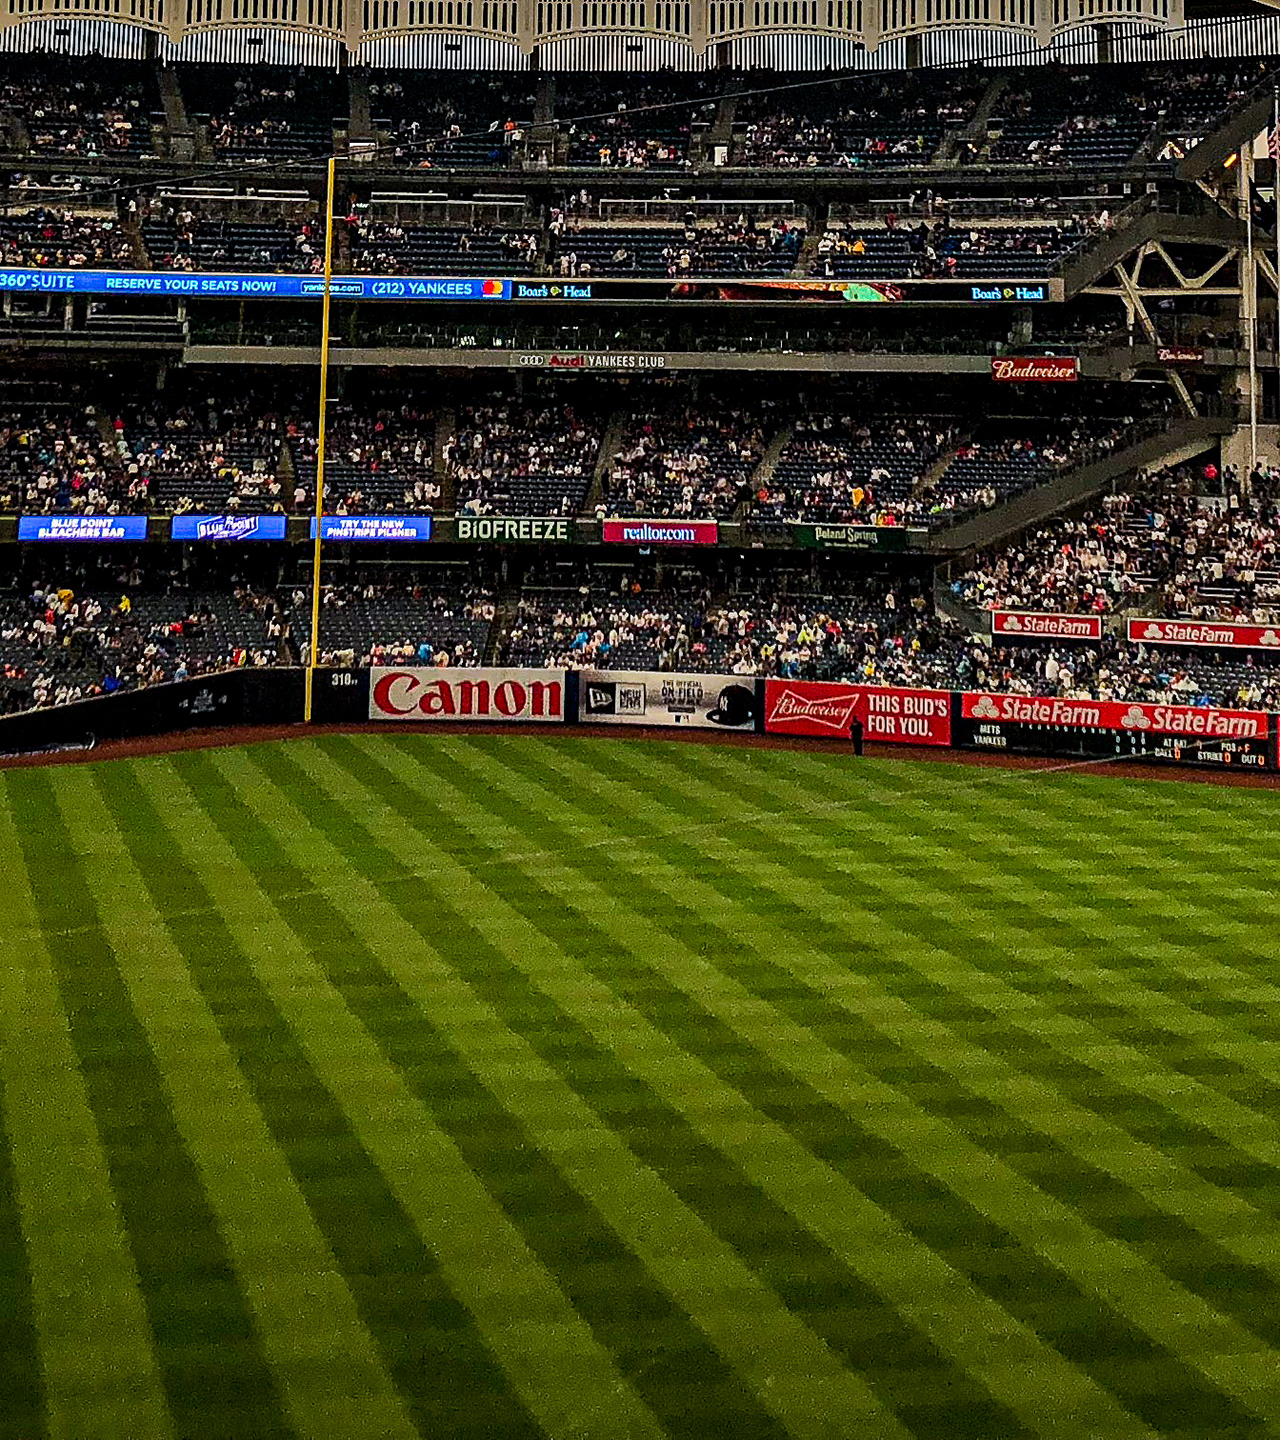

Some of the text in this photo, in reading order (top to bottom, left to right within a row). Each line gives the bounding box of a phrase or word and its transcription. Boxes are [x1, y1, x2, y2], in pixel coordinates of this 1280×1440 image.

[106, 277, 161, 290] RESERVE
[164, 279, 199, 291] YOUR
[202, 280, 240, 292] SEATS
[242, 281, 276, 292] NOW!
[372, 282, 405, 295] (212)
[409, 282, 473, 295] YANKEES
[518, 285, 592, 297] Boar's Head
[972, 286, 1044, 300] Boar's Head
[588, 355, 635, 367] YANKEES
[638, 356, 665, 368] CLUB
[993, 360, 1075, 379] Budweiser
[623, 524, 696, 541] realtor.com
[373, 671, 561, 716] Canon
[776, 697, 850, 717] Budweiser
[867, 693, 947, 717] THIS BUD'S
[868, 714, 933, 736] FOR YOU.
